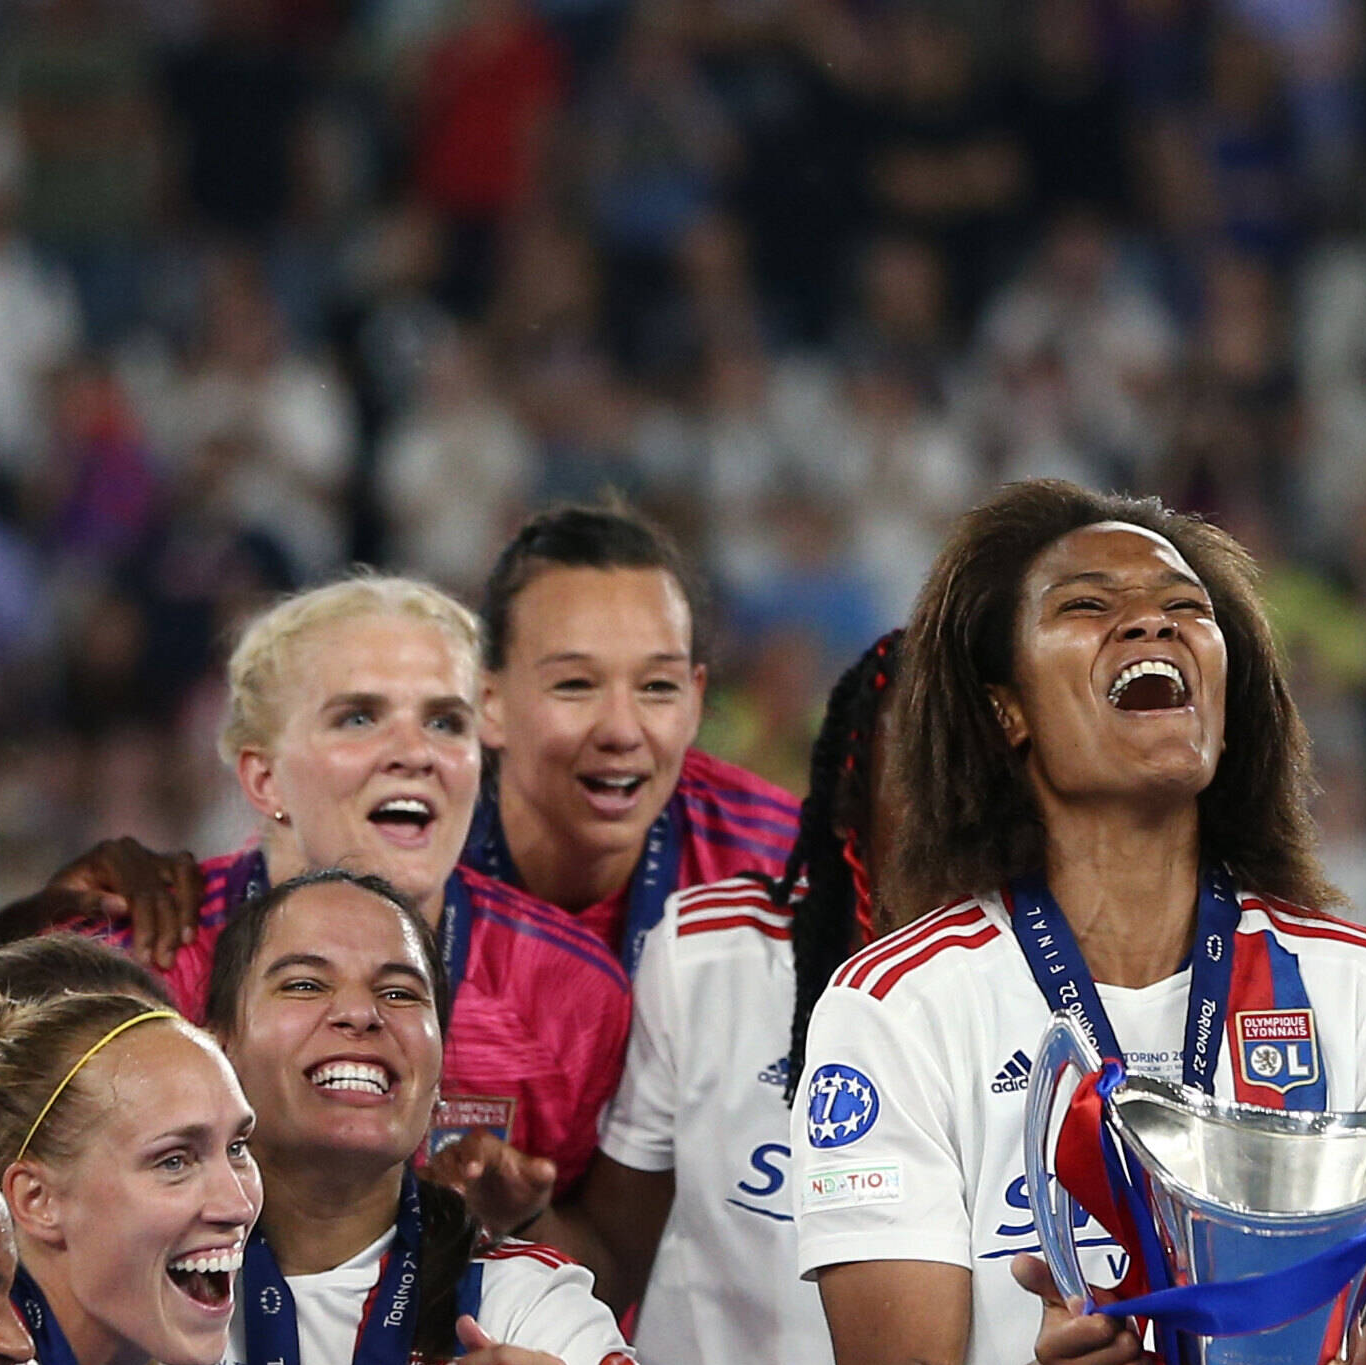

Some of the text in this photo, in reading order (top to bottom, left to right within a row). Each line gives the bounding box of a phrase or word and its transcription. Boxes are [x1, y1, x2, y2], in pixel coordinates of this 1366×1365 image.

[1026, 906, 1080, 1004] 22 FINAL
[1196, 999, 1217, 1054] TORINO
[1244, 1016, 1306, 1029] OLYMPIQUE
[1245, 1026, 1308, 1038] LYONNAIS
[1250, 1043, 1311, 1078] OL
[820, 1086, 838, 1119] 7
[383, 1275, 415, 1327] TORINO
